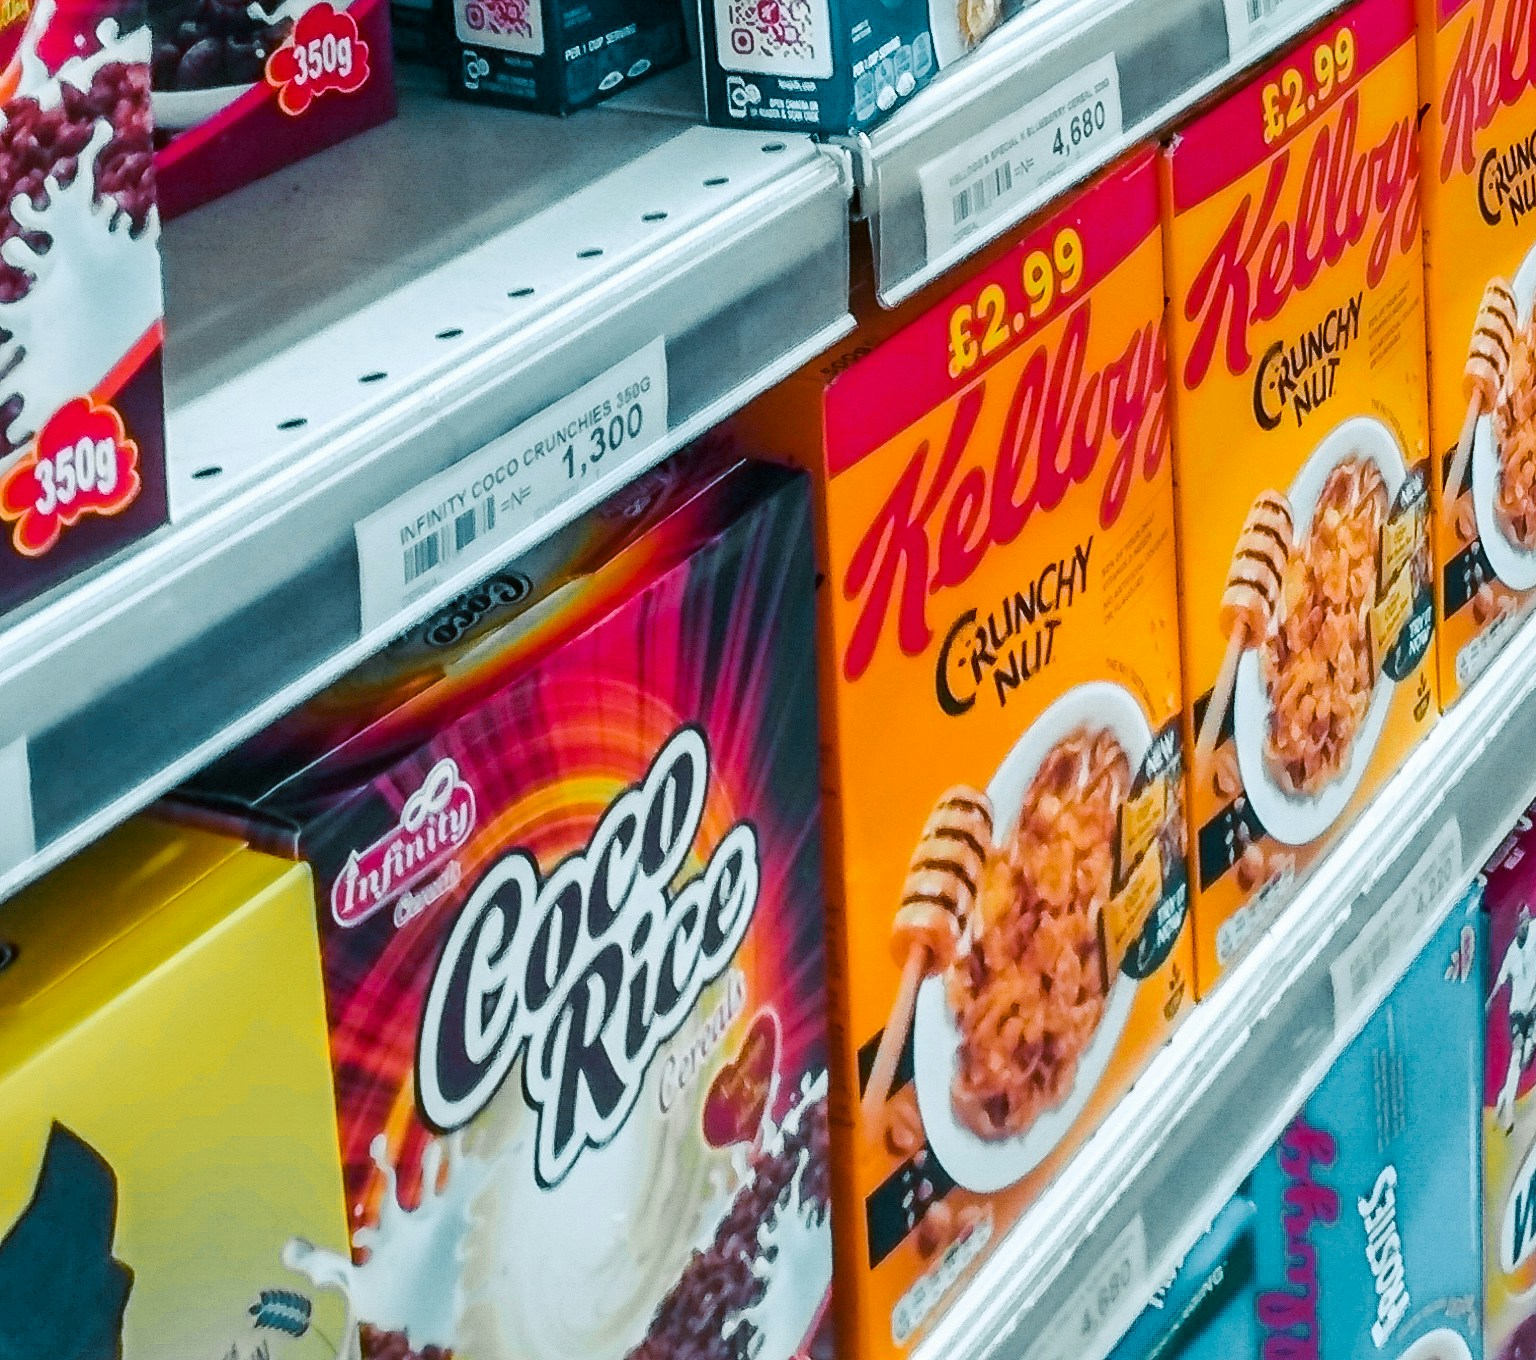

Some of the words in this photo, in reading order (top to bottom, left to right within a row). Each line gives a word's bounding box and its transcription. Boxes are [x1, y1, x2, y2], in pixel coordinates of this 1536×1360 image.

[293, 32, 353, 85] 350g
[1260, 25, 1357, 146] £2.99
[1051, 100, 1107, 159] 4,680
[947, 226, 1086, 381] £2.99
[1252, 290, 1364, 433] CRUNCHY
[559, 401, 644, 481] 1,300
[1293, 356, 1342, 429] NUT
[34, 436, 118, 518] 350g
[400, 492, 467, 547] INFINITY
[471, 457, 520, 500] COCO
[522, 399, 613, 467] CRUNCHIES
[935, 534, 1095, 718] CRUNCHY
[992, 618, 1063, 708] NUT
[338, 807, 471, 917] Infinity
[422, 728, 707, 1132] Coco
[522, 825, 760, 1183] Rice
[657, 966, 749, 1115] Cereals
[1357, 1164, 1411, 1350] FROSTIES
